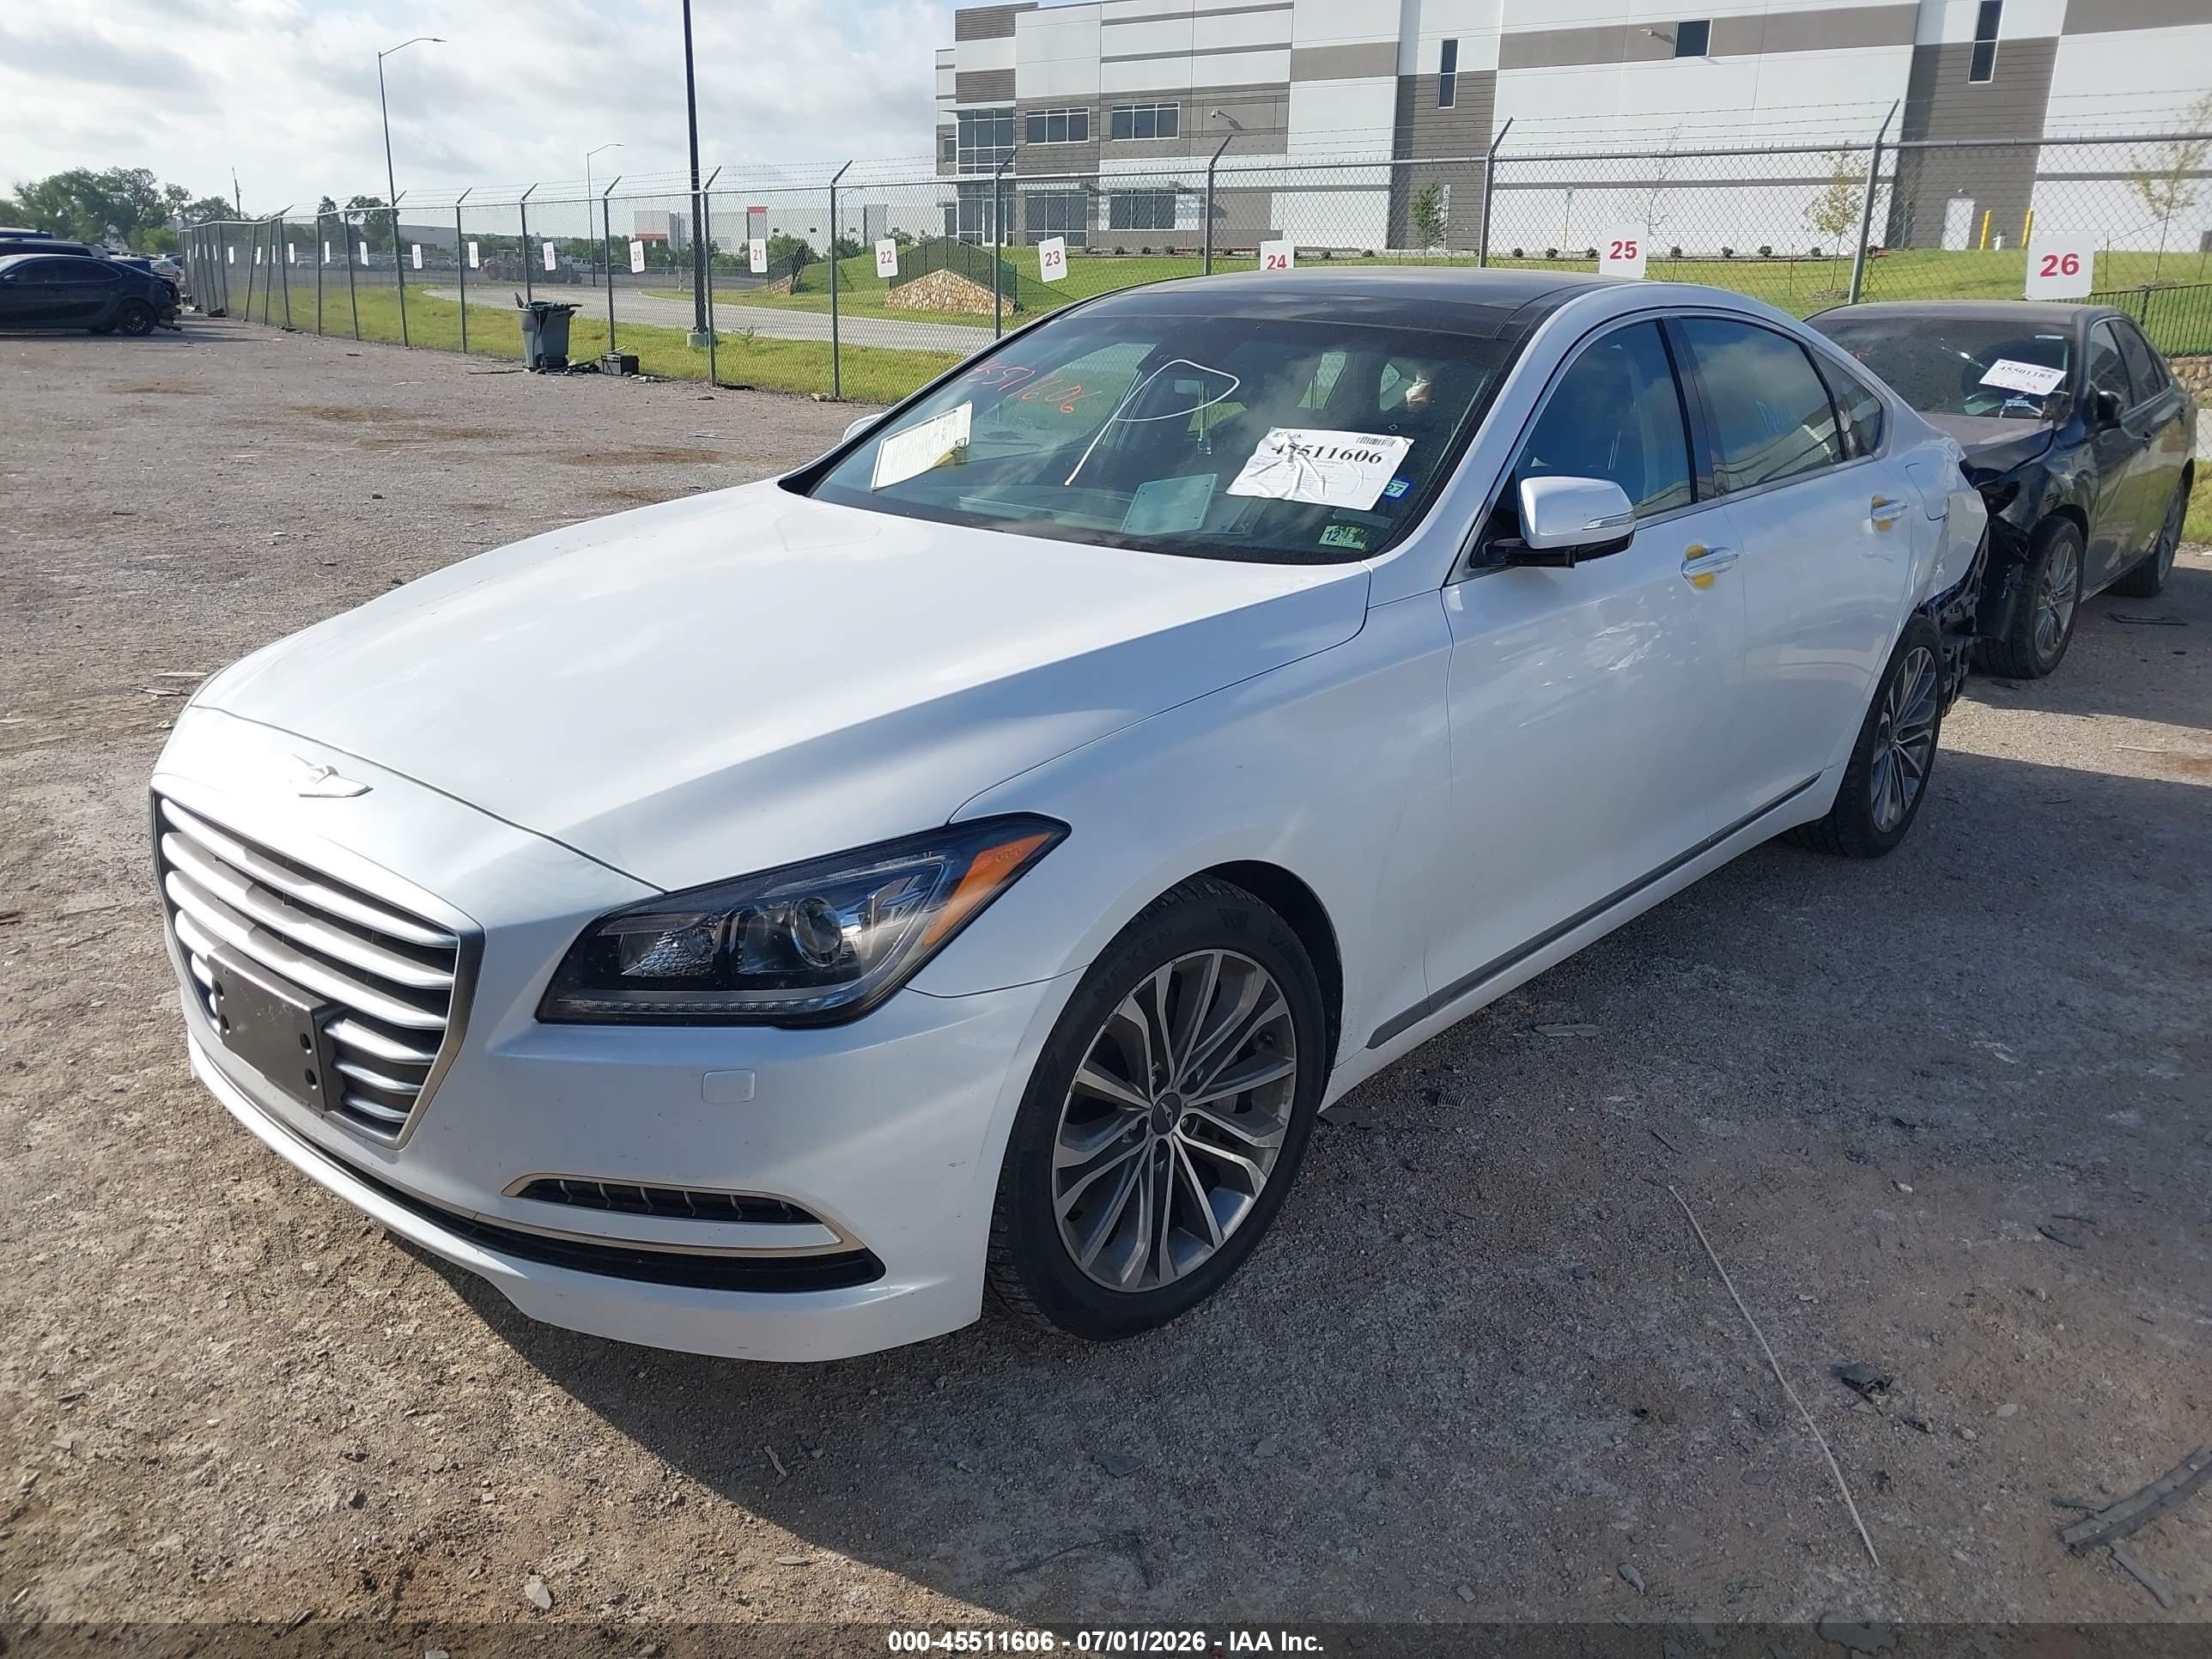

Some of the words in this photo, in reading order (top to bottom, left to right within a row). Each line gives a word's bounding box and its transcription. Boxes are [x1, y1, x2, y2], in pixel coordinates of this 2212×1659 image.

[633, 250, 642, 262] 20
[752, 249, 763, 261] 21
[879, 249, 893, 264] 22
[1607, 240, 1638, 260] 25
[1044, 250, 1061, 267] 23
[1267, 254, 1288, 270] 24
[2039, 253, 2081, 277] 26
[1271, 442, 1387, 464] 45511606
[1325, 529, 1341, 542] 12
